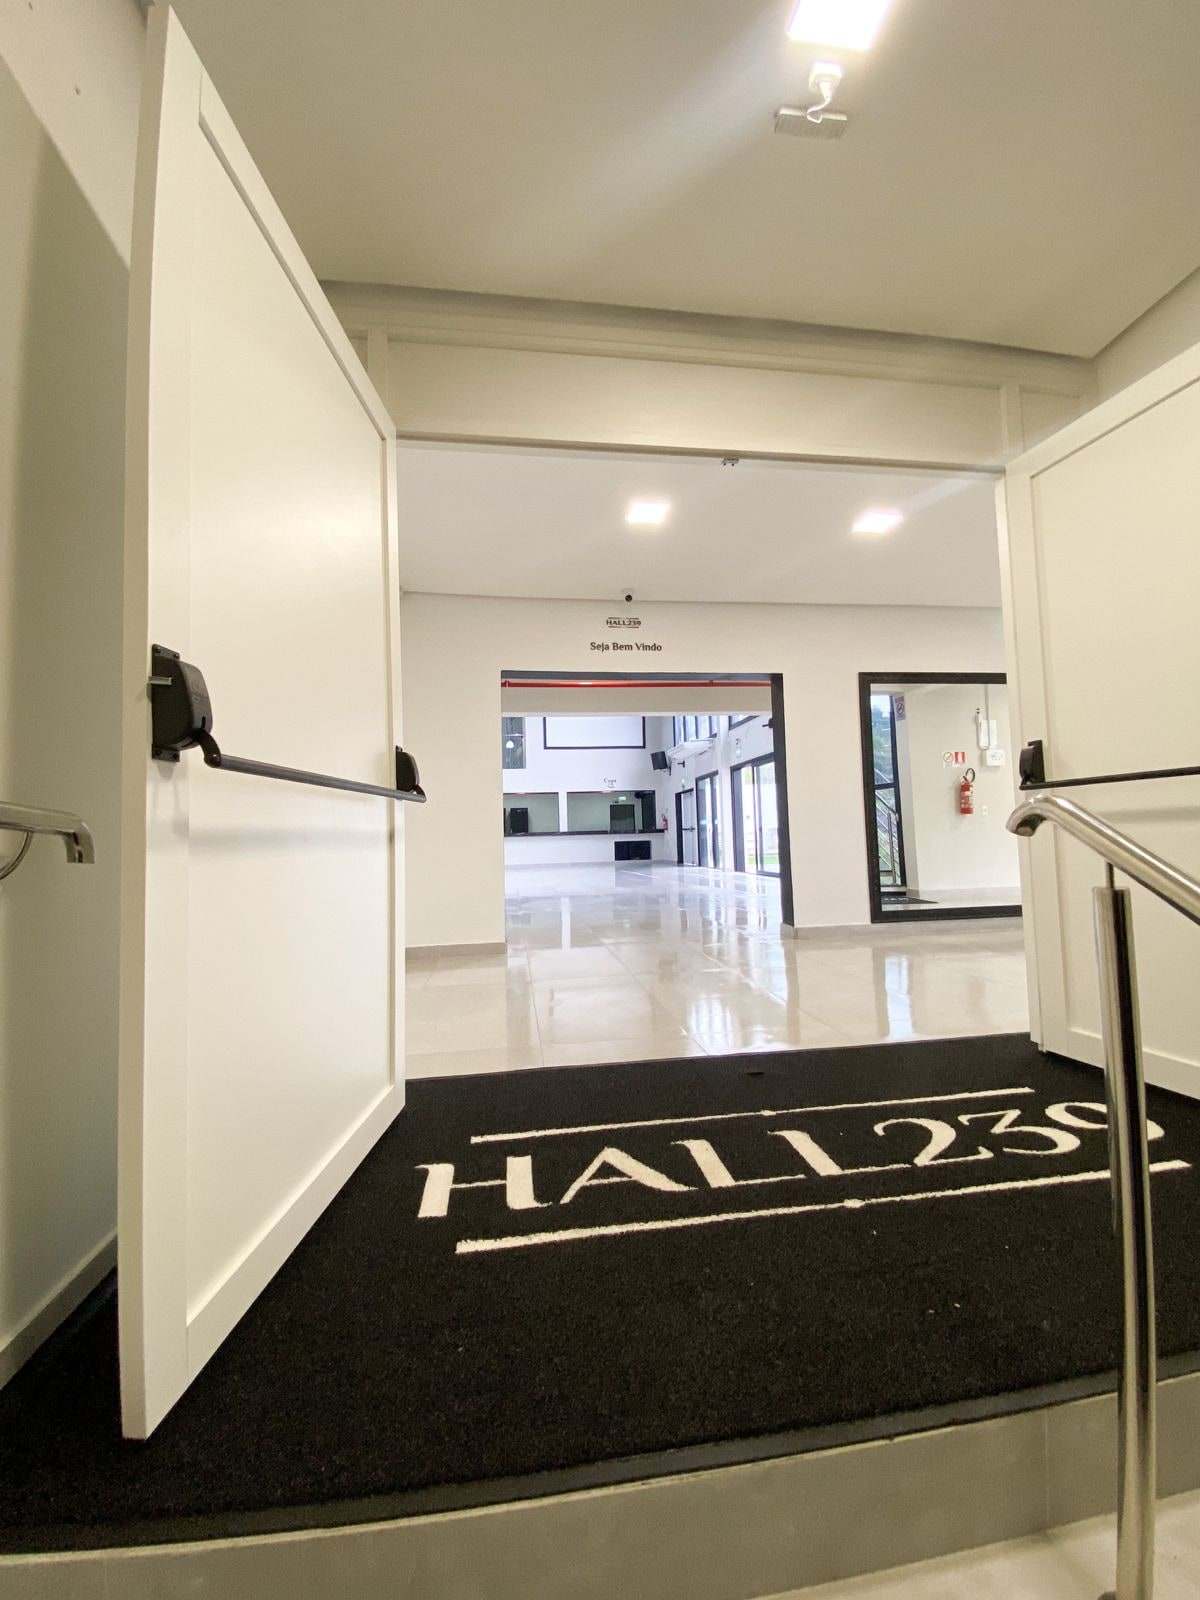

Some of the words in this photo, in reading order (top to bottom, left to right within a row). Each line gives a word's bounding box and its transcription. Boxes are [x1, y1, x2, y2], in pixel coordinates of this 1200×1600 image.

[590, 641, 610, 652] Seja
[612, 642, 633, 651] Bem
[635, 642, 663, 652] Vindo
